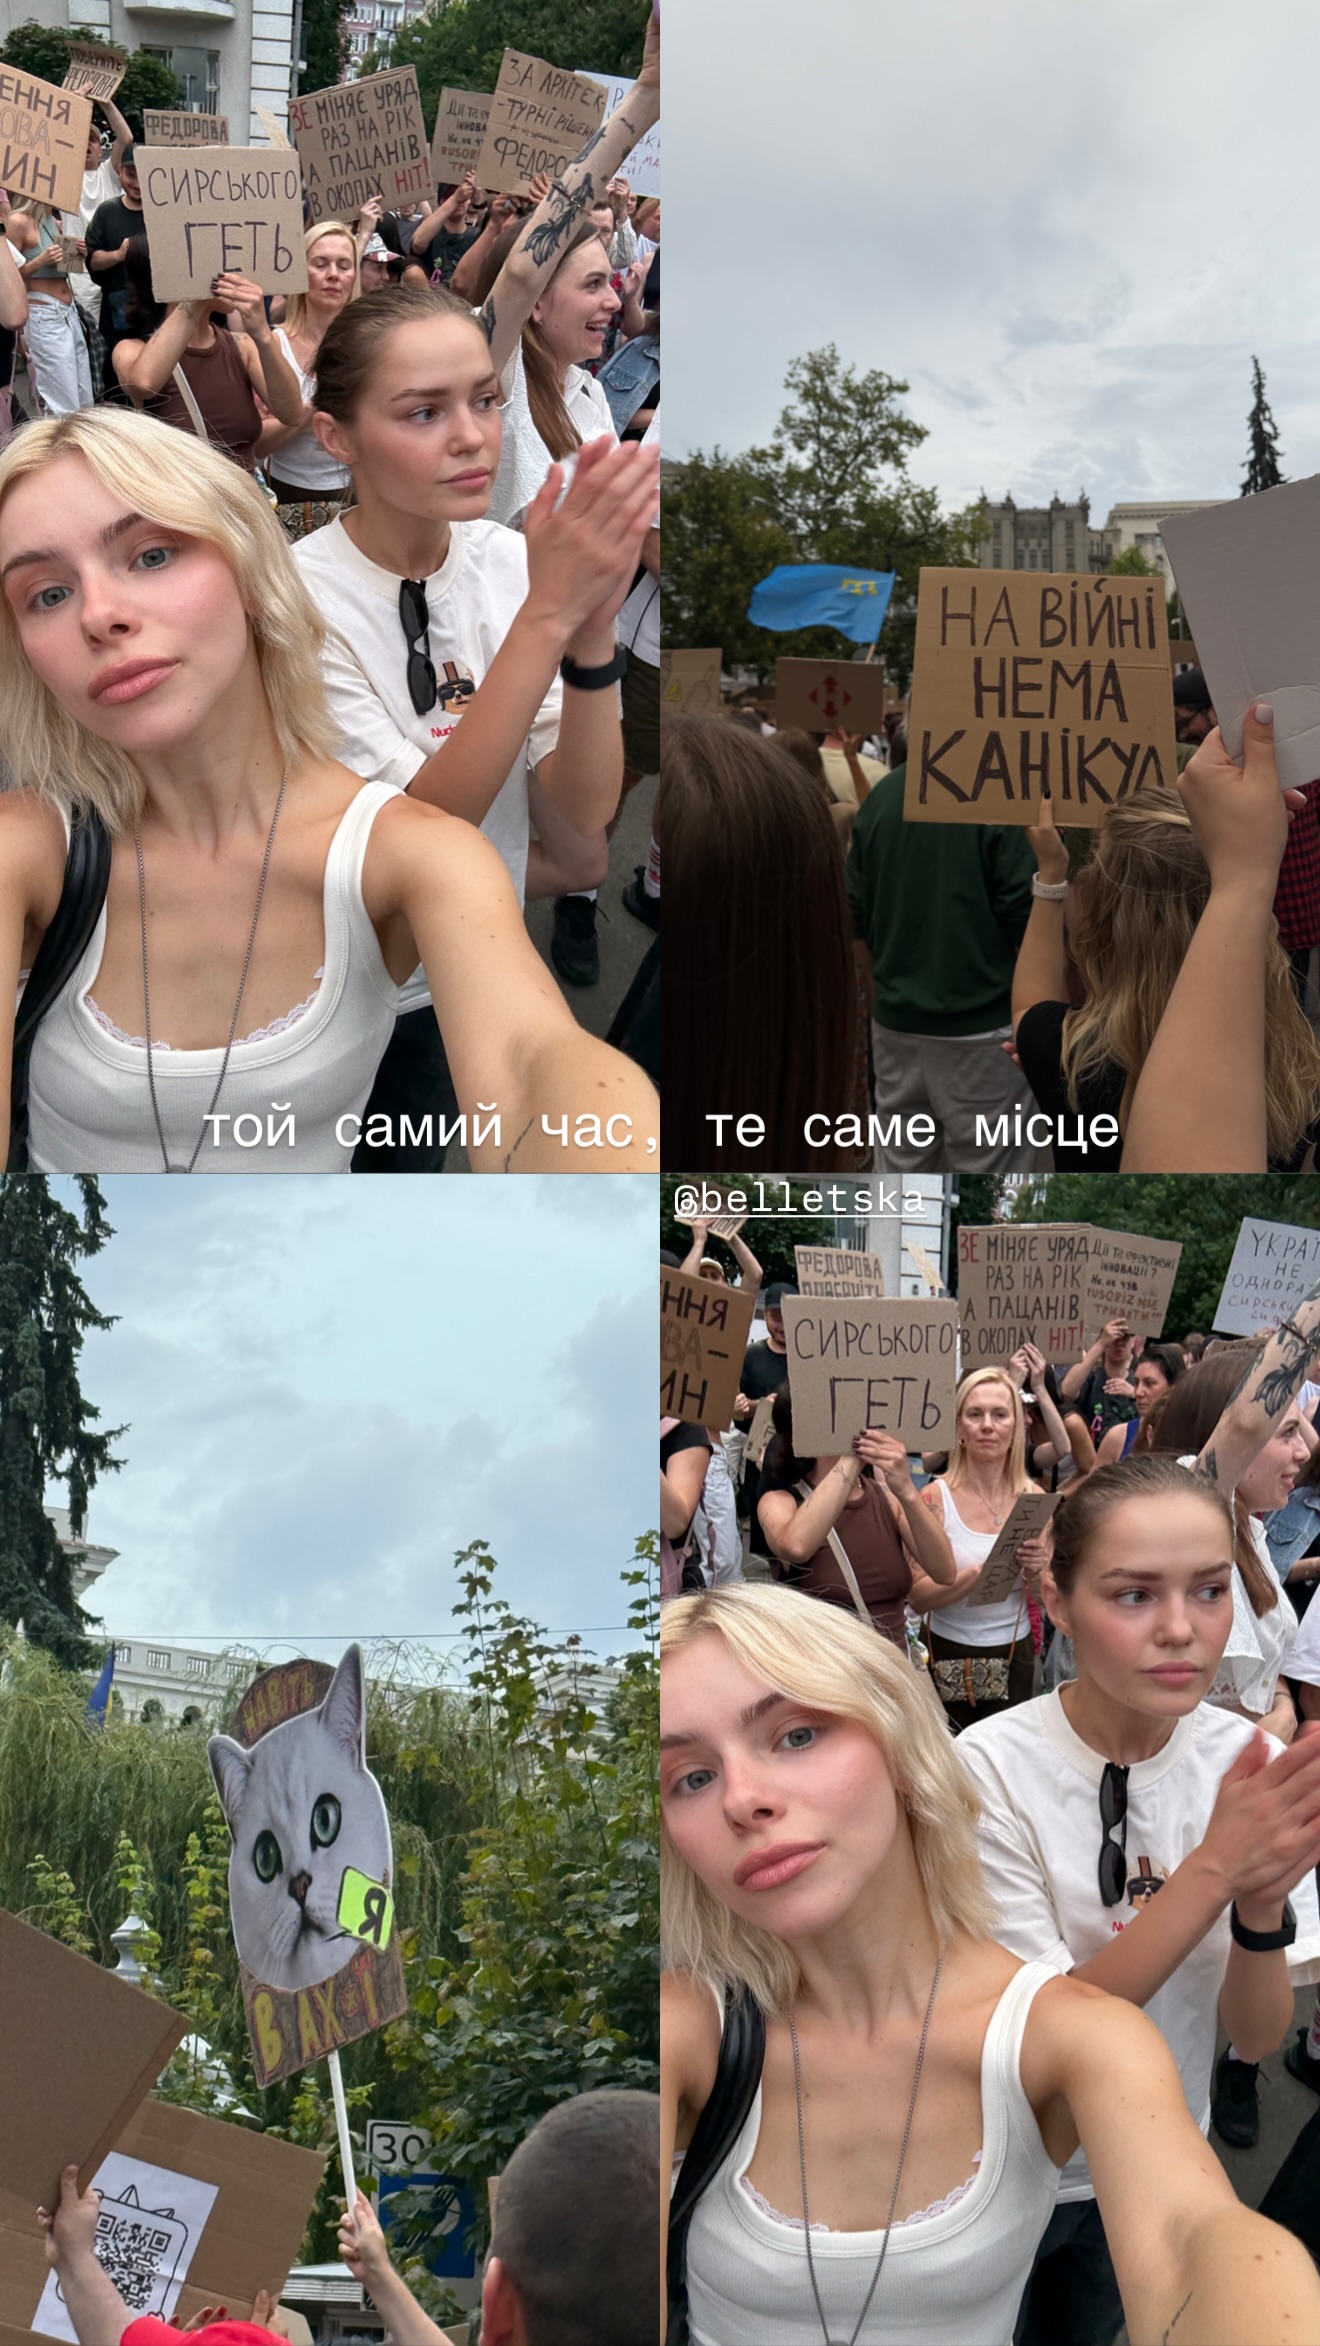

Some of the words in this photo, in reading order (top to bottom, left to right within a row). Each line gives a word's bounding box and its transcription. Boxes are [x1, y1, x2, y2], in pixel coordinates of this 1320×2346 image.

[504, 59, 533, 88] ЗА
[0, 74, 71, 125] ЕННЯ
[289, 102, 313, 132] ЗЕ
[315, 95, 368, 125] МІНЯЄ
[374, 78, 418, 110] УРЯД
[146, 115, 229, 142] ФЕДОРОВА
[321, 123, 350, 152] РАЗ
[356, 118, 379, 142] НА
[385, 106, 416, 135] РІК
[2, 145, 57, 200] ИН
[309, 163, 321, 186] А
[329, 134, 421, 178] ПАЦАНІВ
[147, 167, 297, 207] СИРСЬКОГО
[310, 192, 322, 217] В
[327, 173, 385, 212] ОКОПАХ
[394, 157, 432, 194] НІТ!
[184, 221, 293, 279] ГЕТЬ
[941, 586, 1020, 646] НА
[1040, 578, 1156, 650] ВІЙНІ
[973, 656, 1129, 723] НЕМА
[919, 728, 1165, 806] КАНІКУЛ
[797, 1251, 882, 1280] ФЕДОРОВА
[960, 1232, 980, 1262] ЗЕ
[986, 1232, 1038, 1262] МІНЯЄ
[1047, 1236, 1089, 1262] УРЯД
[1275, 1261, 1302, 1279] НЕ
[986, 1264, 1015, 1291] РАЗ
[1023, 1265, 1043, 1289] НА
[1052, 1264, 1082, 1289] РІК
[1232, 1272, 1314, 1294] ОДНОРА
[660, 1279, 729, 1331] ННЯ
[963, 1298, 976, 1321] А
[988, 1294, 1080, 1321] ПАЦАНІВ
[794, 1318, 954, 1360] СИРСЬКОГО
[962, 1328, 971, 1356] В
[978, 1325, 1037, 1354] ОКОПАХ
[1048, 1319, 1084, 1352] НІТ!
[829, 1376, 941, 1434] ГЕТЬ
[359, 1887, 387, 1944] Я
